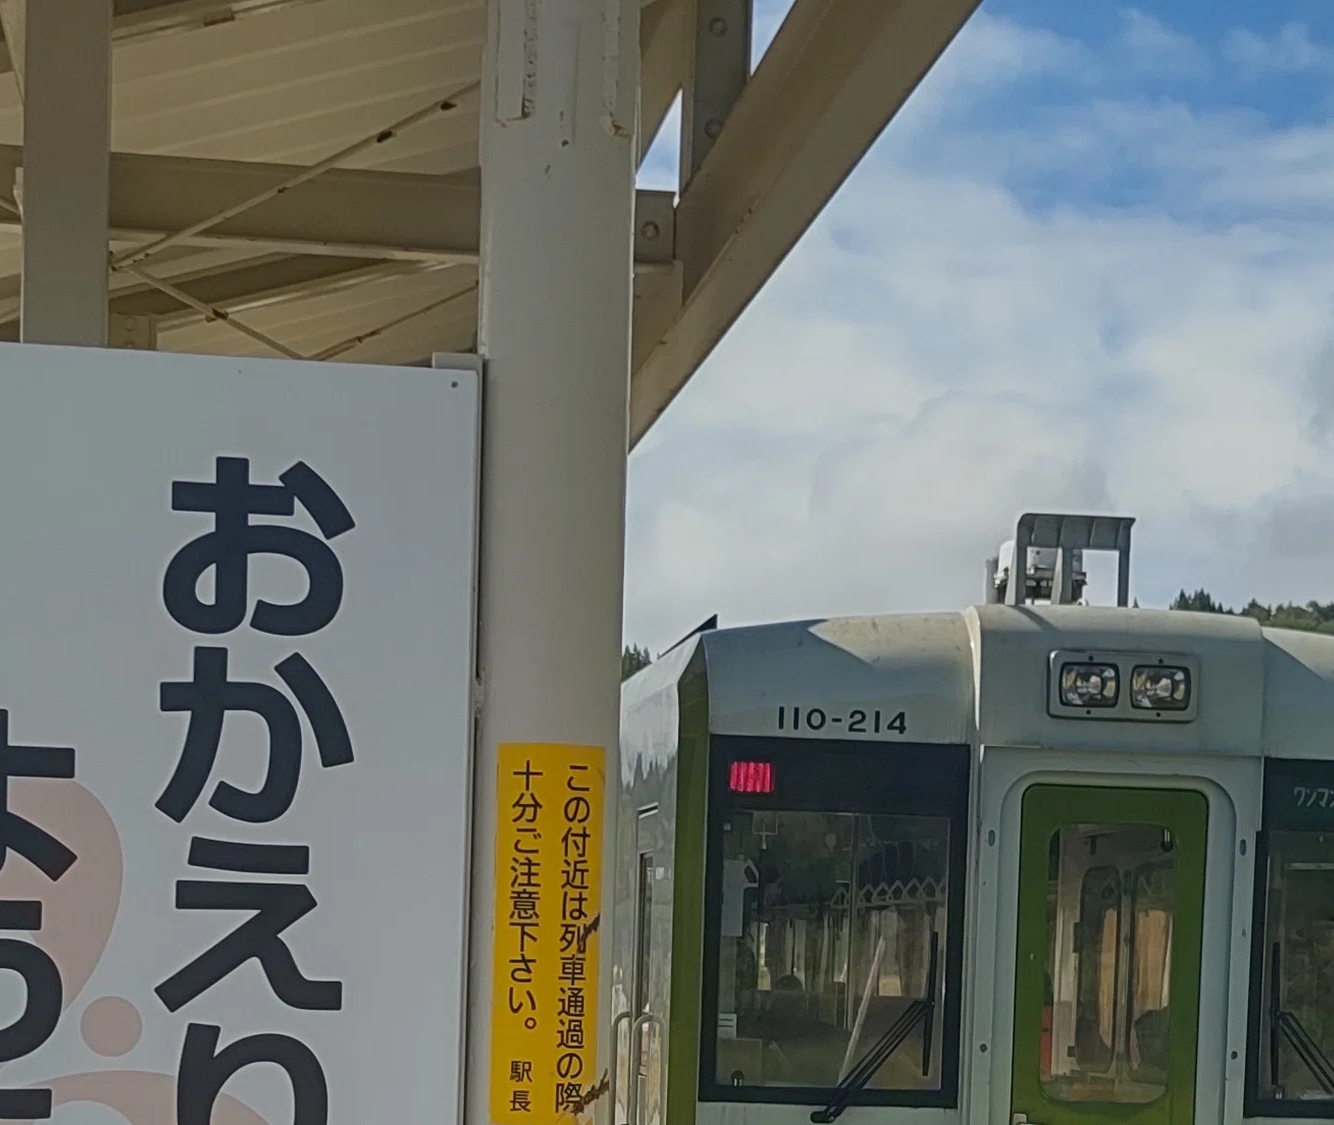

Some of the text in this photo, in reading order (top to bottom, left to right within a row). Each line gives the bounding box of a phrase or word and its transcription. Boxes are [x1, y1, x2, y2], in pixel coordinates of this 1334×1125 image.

[778, 706, 907, 734] 110-214
[509, 760, 544, 1112] 十分ご注意下さい。 駅長
[555, 764, 591, 1114] この付近は列車通過の際
